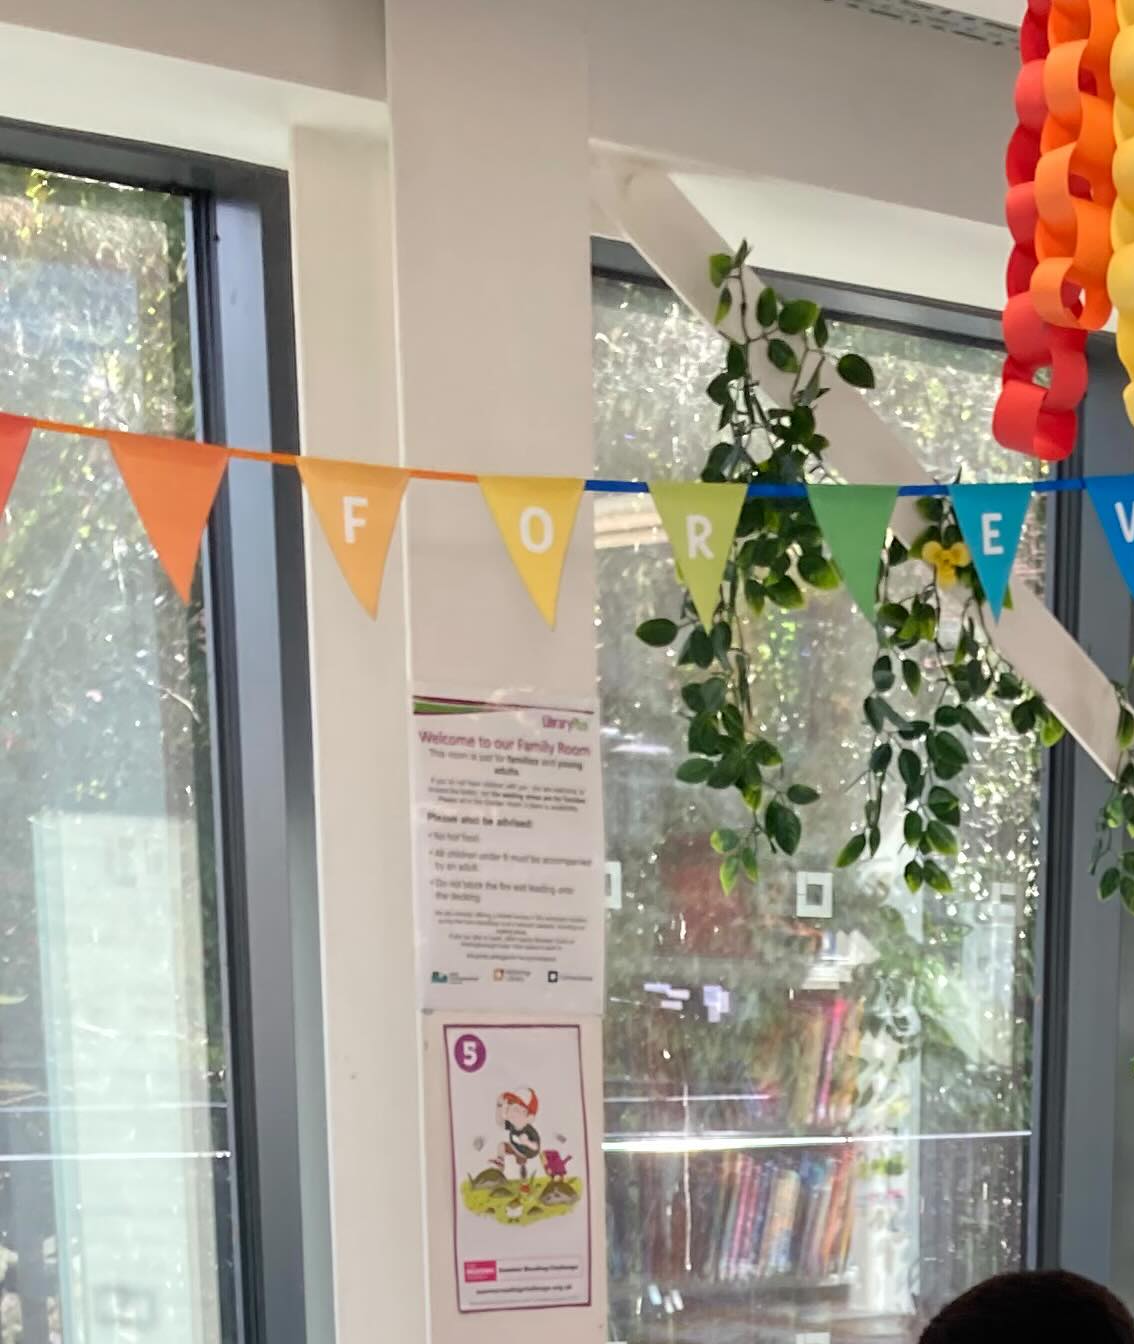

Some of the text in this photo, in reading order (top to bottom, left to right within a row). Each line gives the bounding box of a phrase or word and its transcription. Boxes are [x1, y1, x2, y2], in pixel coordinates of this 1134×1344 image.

[343, 496, 712, 557] FOR
[419, 730, 592, 756] Welcome to our Family Room
[463, 1040, 477, 1066] 5
